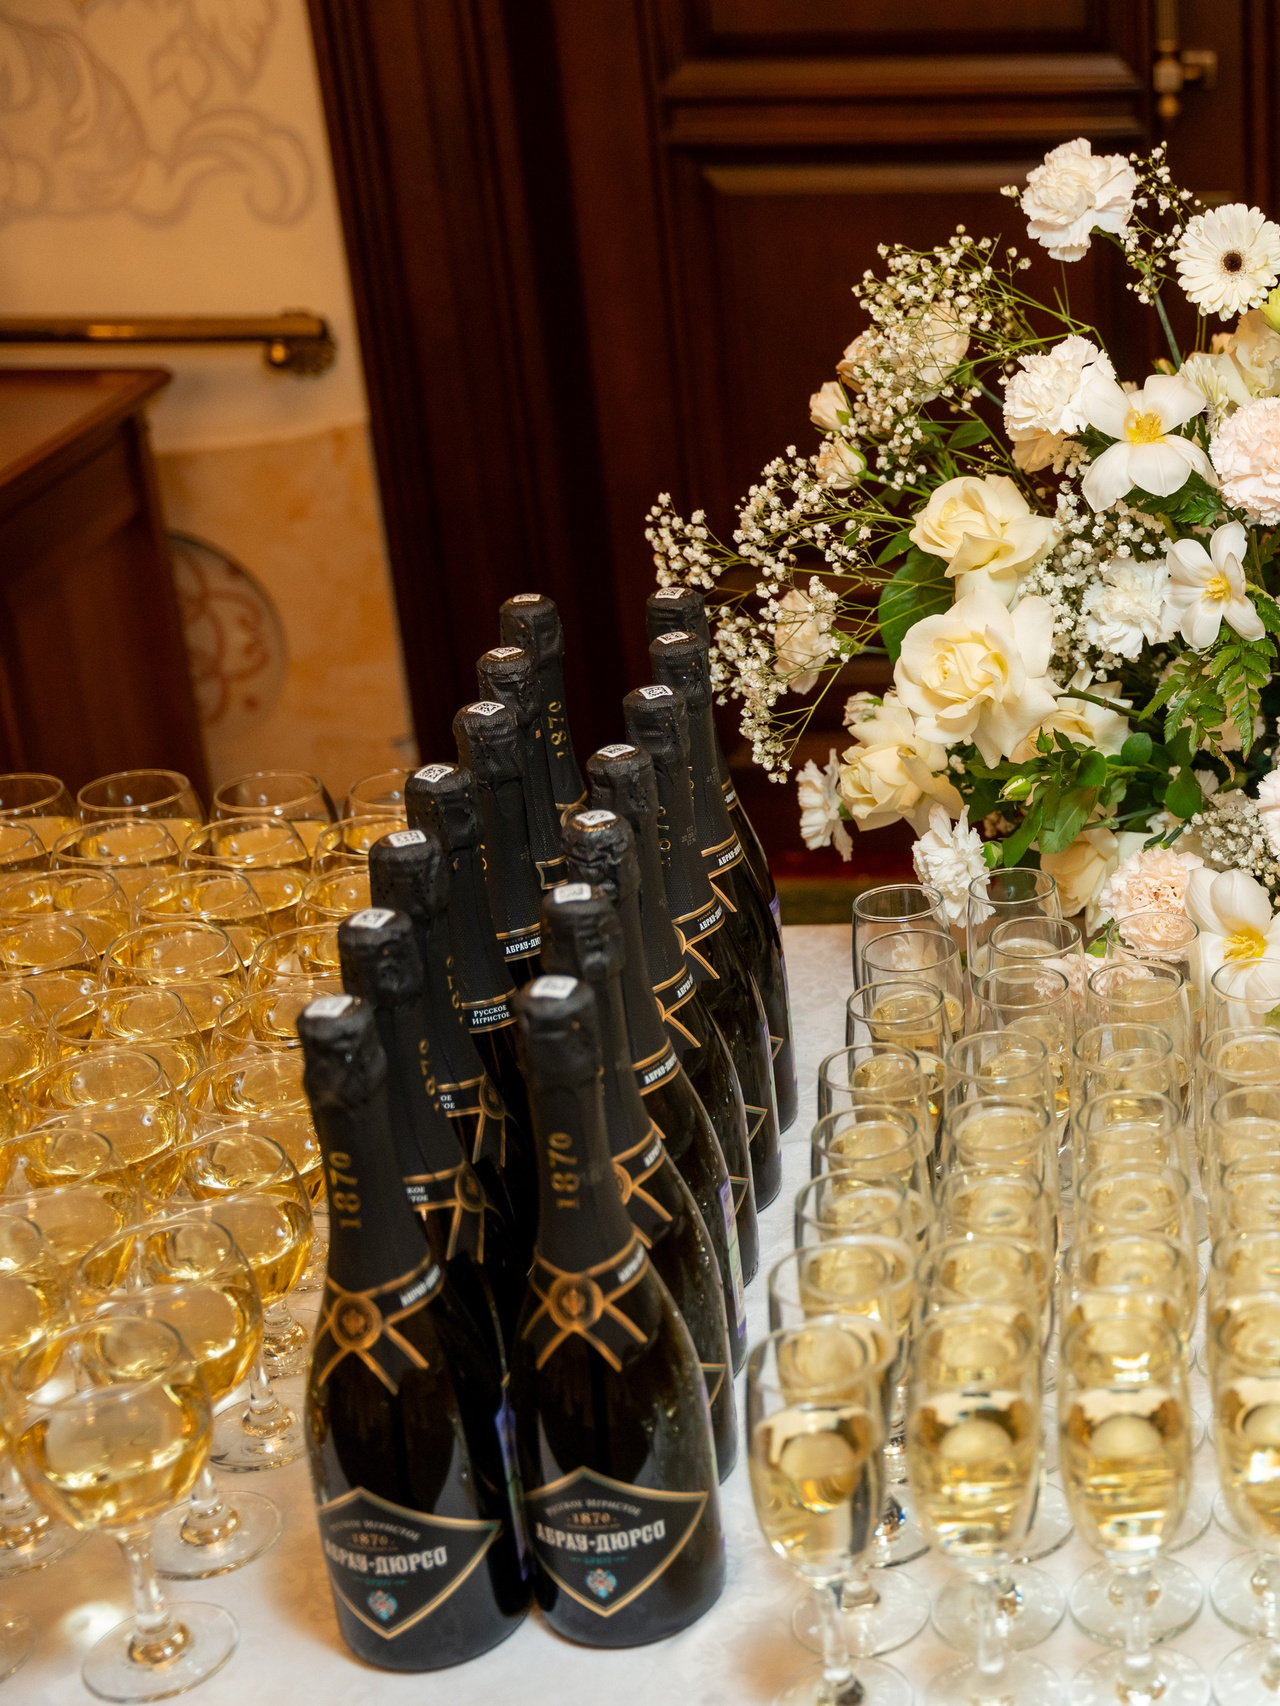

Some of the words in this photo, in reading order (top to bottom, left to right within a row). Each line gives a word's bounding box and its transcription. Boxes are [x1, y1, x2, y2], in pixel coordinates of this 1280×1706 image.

[472, 1011, 511, 1025] ИГРИСТОЕ
[473, 1004, 508, 1017] РУССКОЕ
[547, 1132, 580, 1209] 1870
[329, 1151, 362, 1229] 1870
[571, 1512, 611, 1526] 1870
[535, 1518, 667, 1555] АБРАУ-ДЮРСО
